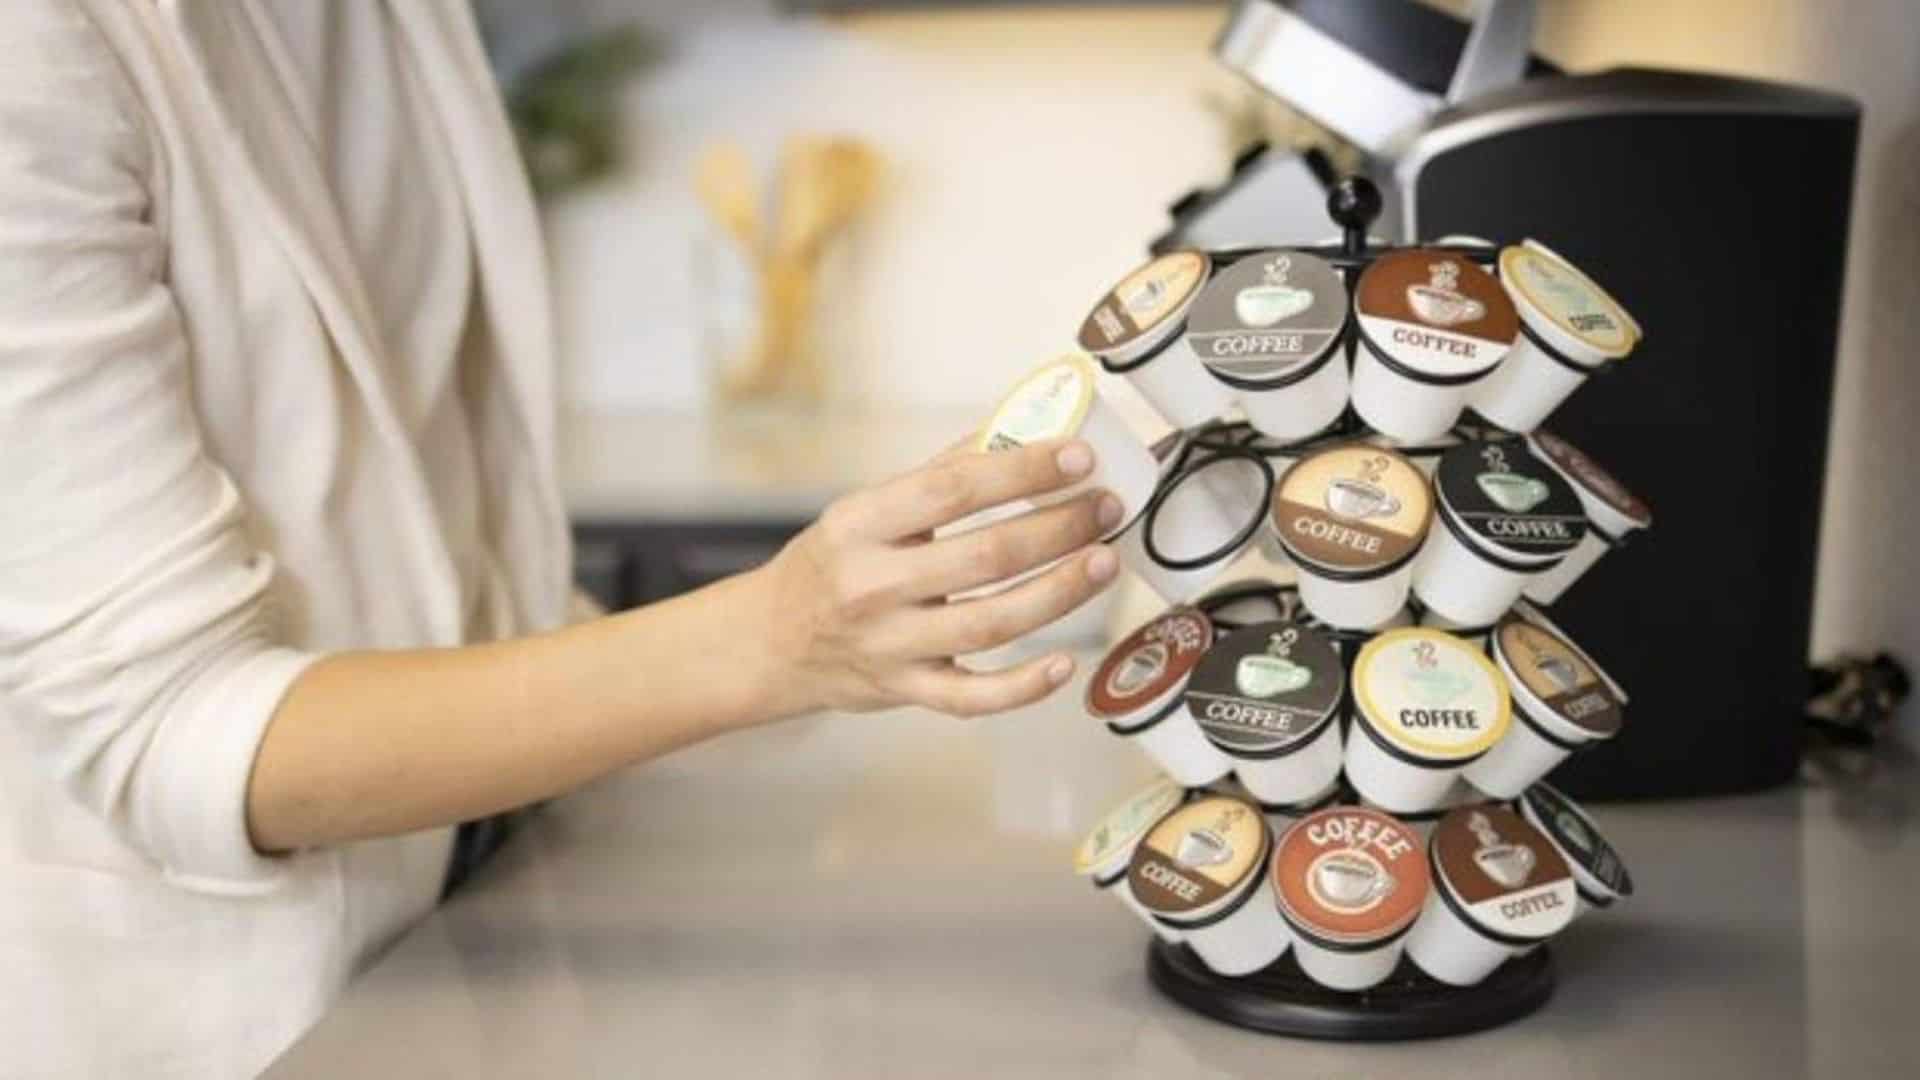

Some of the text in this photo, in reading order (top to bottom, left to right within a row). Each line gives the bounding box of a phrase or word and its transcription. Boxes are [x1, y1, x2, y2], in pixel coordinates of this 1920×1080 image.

[1212, 334, 1303, 355] COFFEE
[1393, 328, 1478, 358] COFFEE
[1293, 517, 1383, 554] COFFEE
[1485, 518, 1571, 538] COFFEE
[1205, 702, 1294, 730] COFFEE
[1399, 709, 1480, 729] COFFEE
[1307, 816, 1413, 860] COFFEE
[1139, 861, 1203, 902] COFFEE
[1500, 892, 1564, 920] COFFEE
